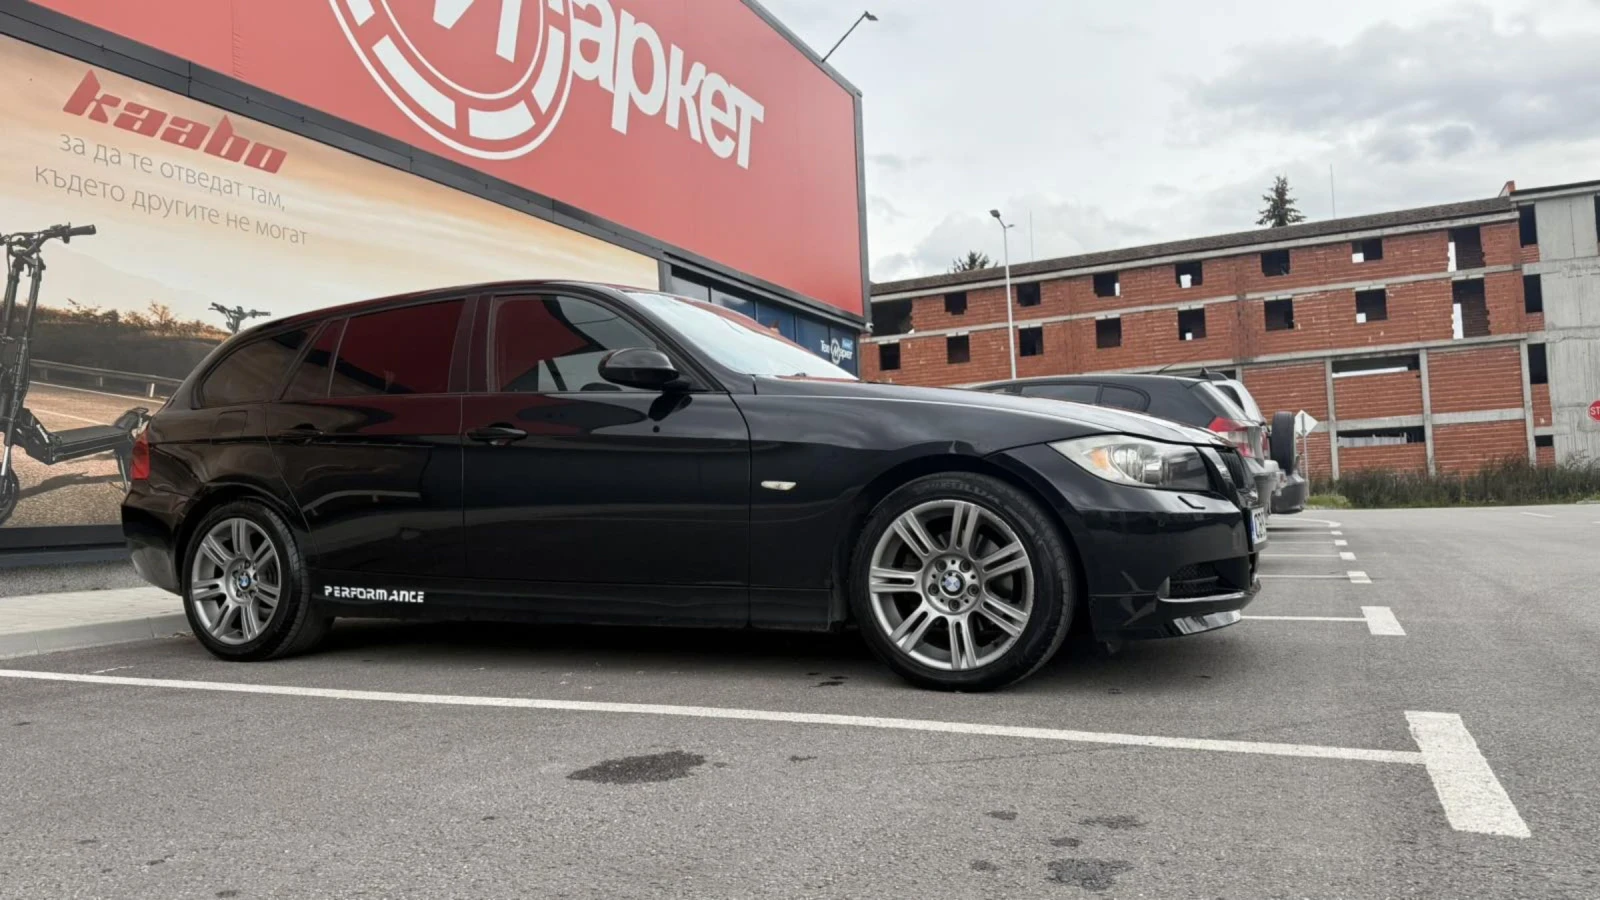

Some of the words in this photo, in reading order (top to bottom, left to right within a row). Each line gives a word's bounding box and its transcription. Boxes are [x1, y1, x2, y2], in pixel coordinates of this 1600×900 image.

[62, 68, 287, 174] kaabo
[35, 165, 125, 203] където
[131, 190, 220, 225] другите
[225, 212, 250, 233] не
[255, 219, 308, 246] могат
[59, 133, 86, 156] за
[93, 143, 121, 166] да
[128, 152, 153, 174] те
[160, 161, 243, 197] отведат
[247, 182, 287, 212] там,
[324, 585, 425, 603] PERFORMANCE
